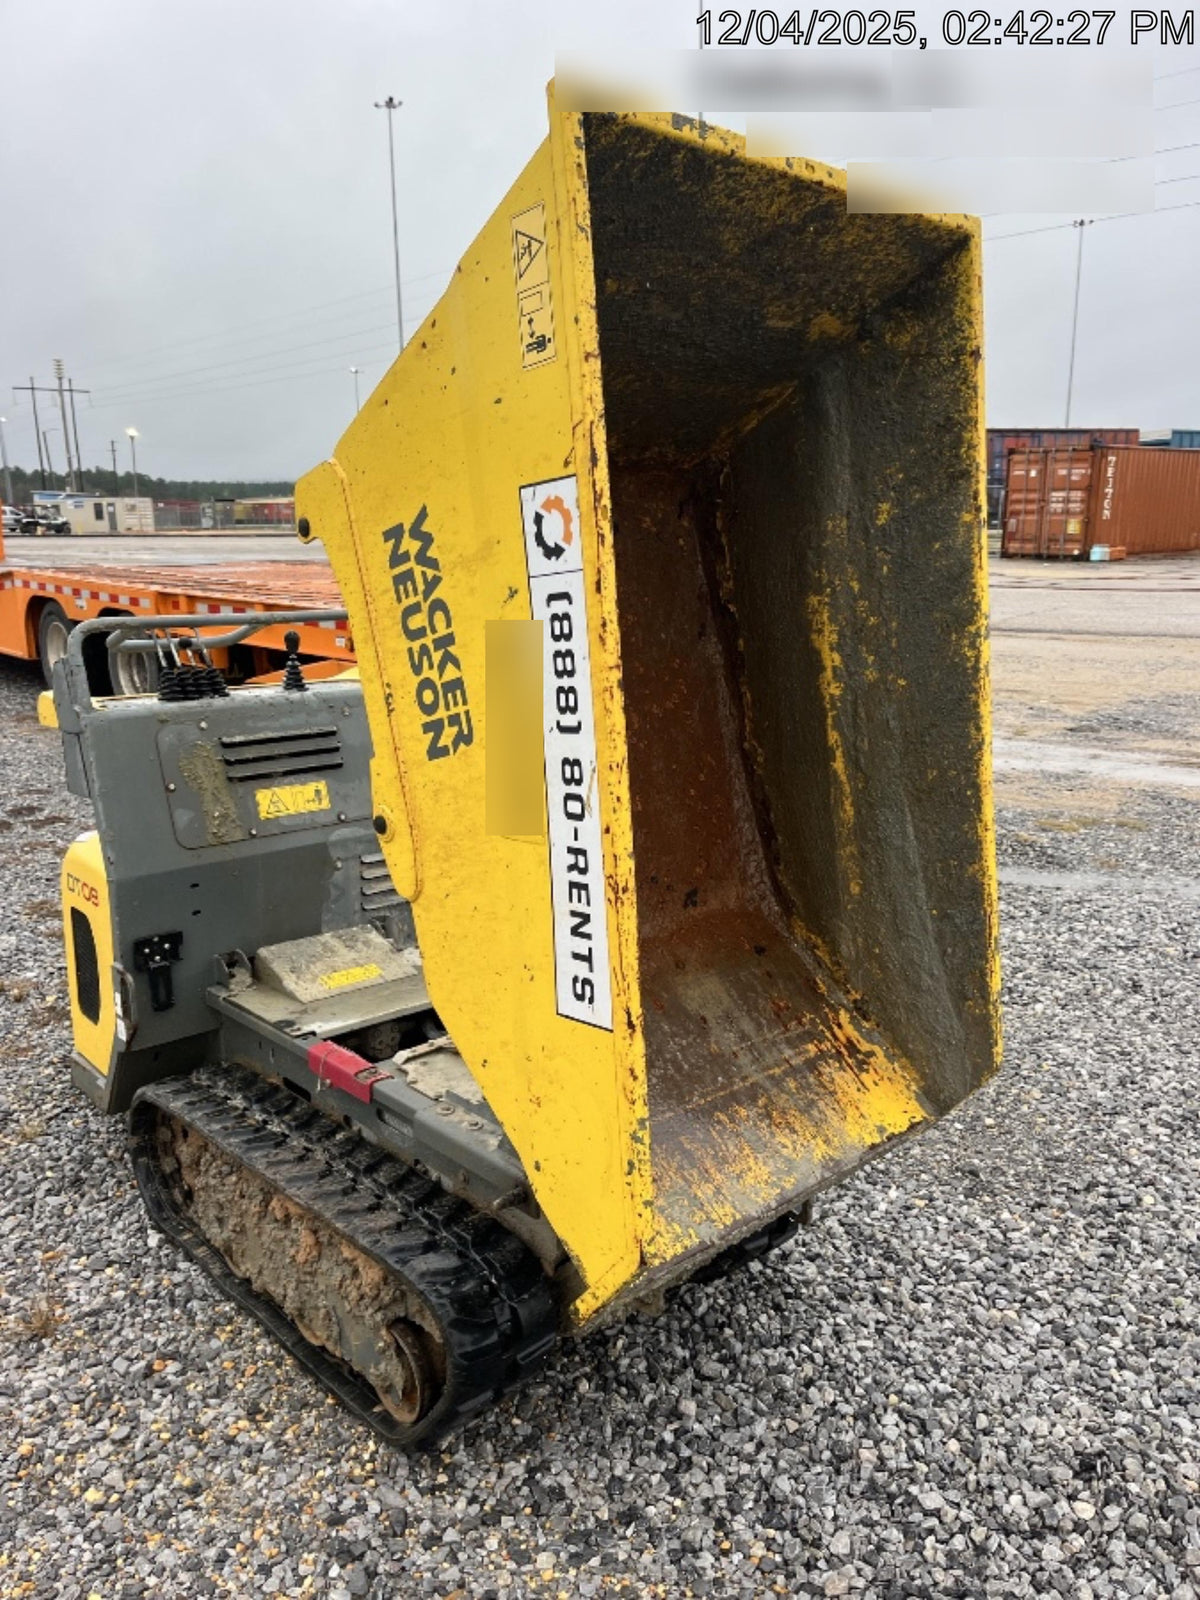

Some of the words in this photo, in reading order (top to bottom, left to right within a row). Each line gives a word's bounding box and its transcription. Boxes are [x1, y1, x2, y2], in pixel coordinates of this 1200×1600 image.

[383, 522, 451, 762] NEUSON
[409, 504, 474, 755] WACKER
[547, 591, 582, 735] (888)
[561, 757, 595, 1005] 80-RENTS
